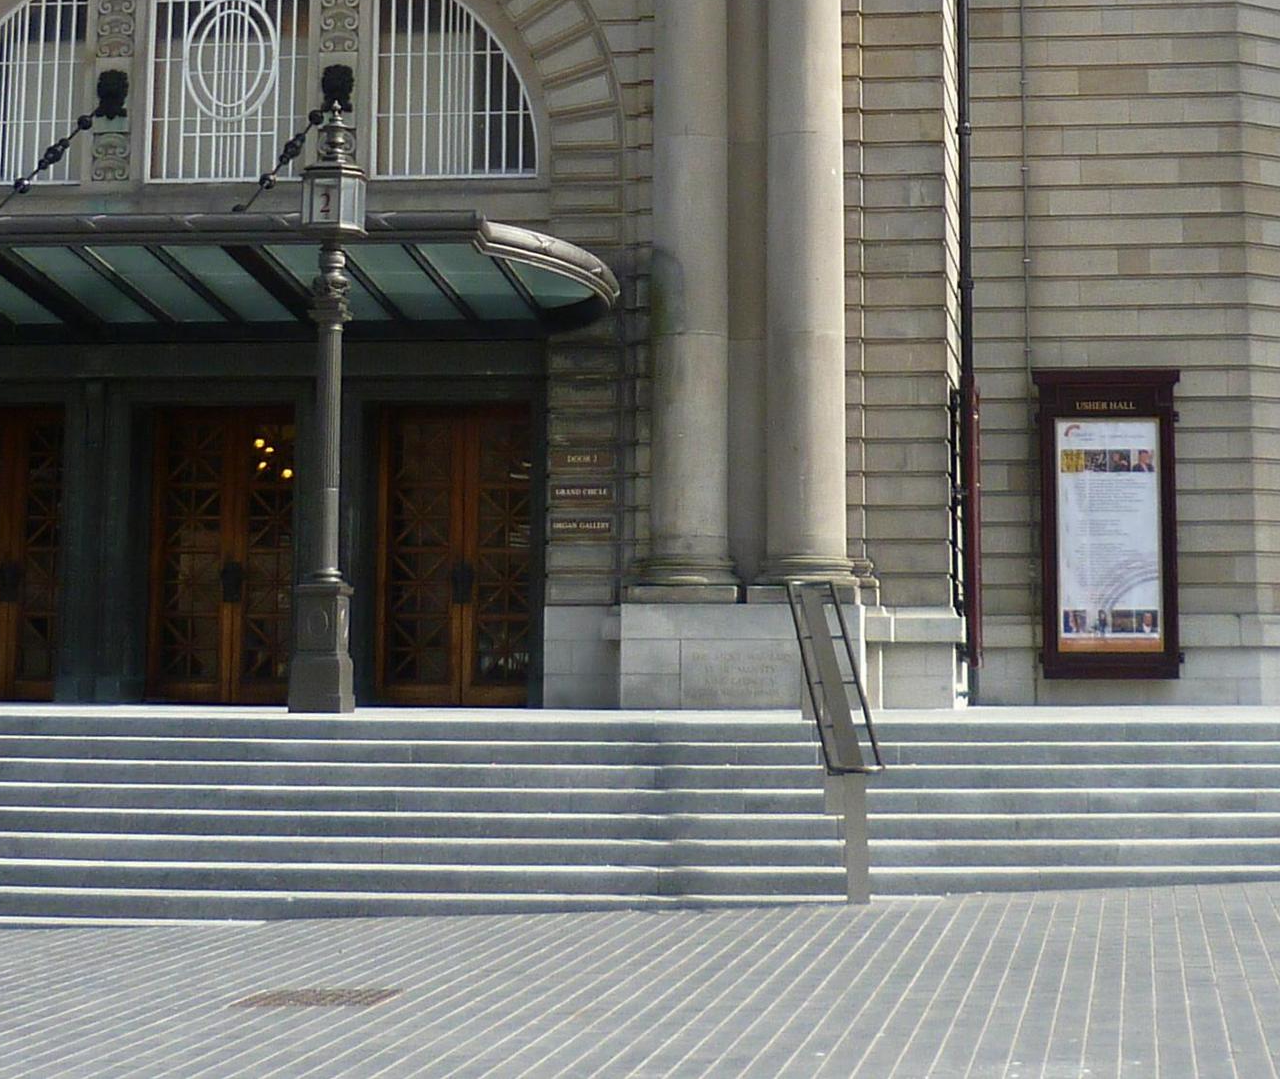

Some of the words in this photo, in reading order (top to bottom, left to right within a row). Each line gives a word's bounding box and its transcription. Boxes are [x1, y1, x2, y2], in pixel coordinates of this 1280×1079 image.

[320, 192, 331, 213] 2
[1074, 401, 1108, 410] USHER
[1109, 401, 1137, 410] HALL
